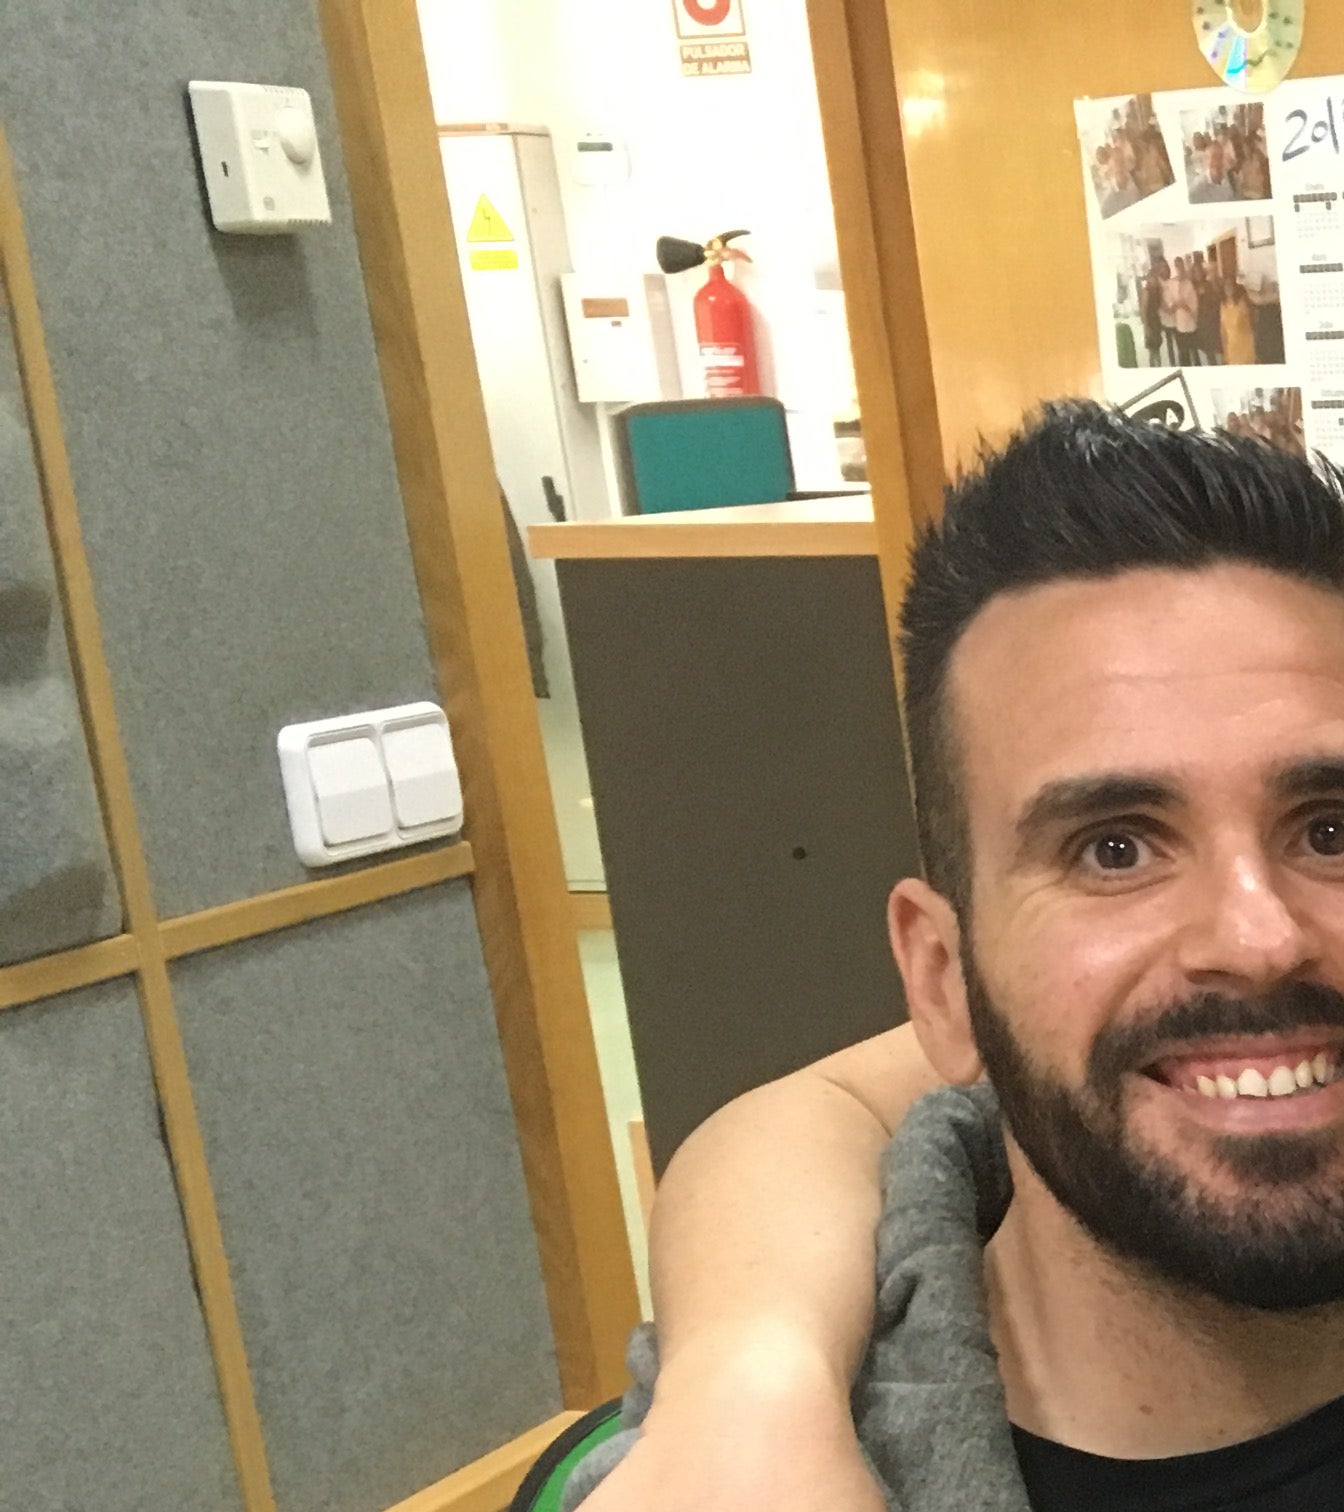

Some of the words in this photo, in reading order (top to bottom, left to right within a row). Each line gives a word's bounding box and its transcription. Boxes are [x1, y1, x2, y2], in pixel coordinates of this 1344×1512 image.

[682, 44, 745, 58] PULSADOR
[682, 62, 699, 76] DE
[702, 60, 750, 75] ALARMA
